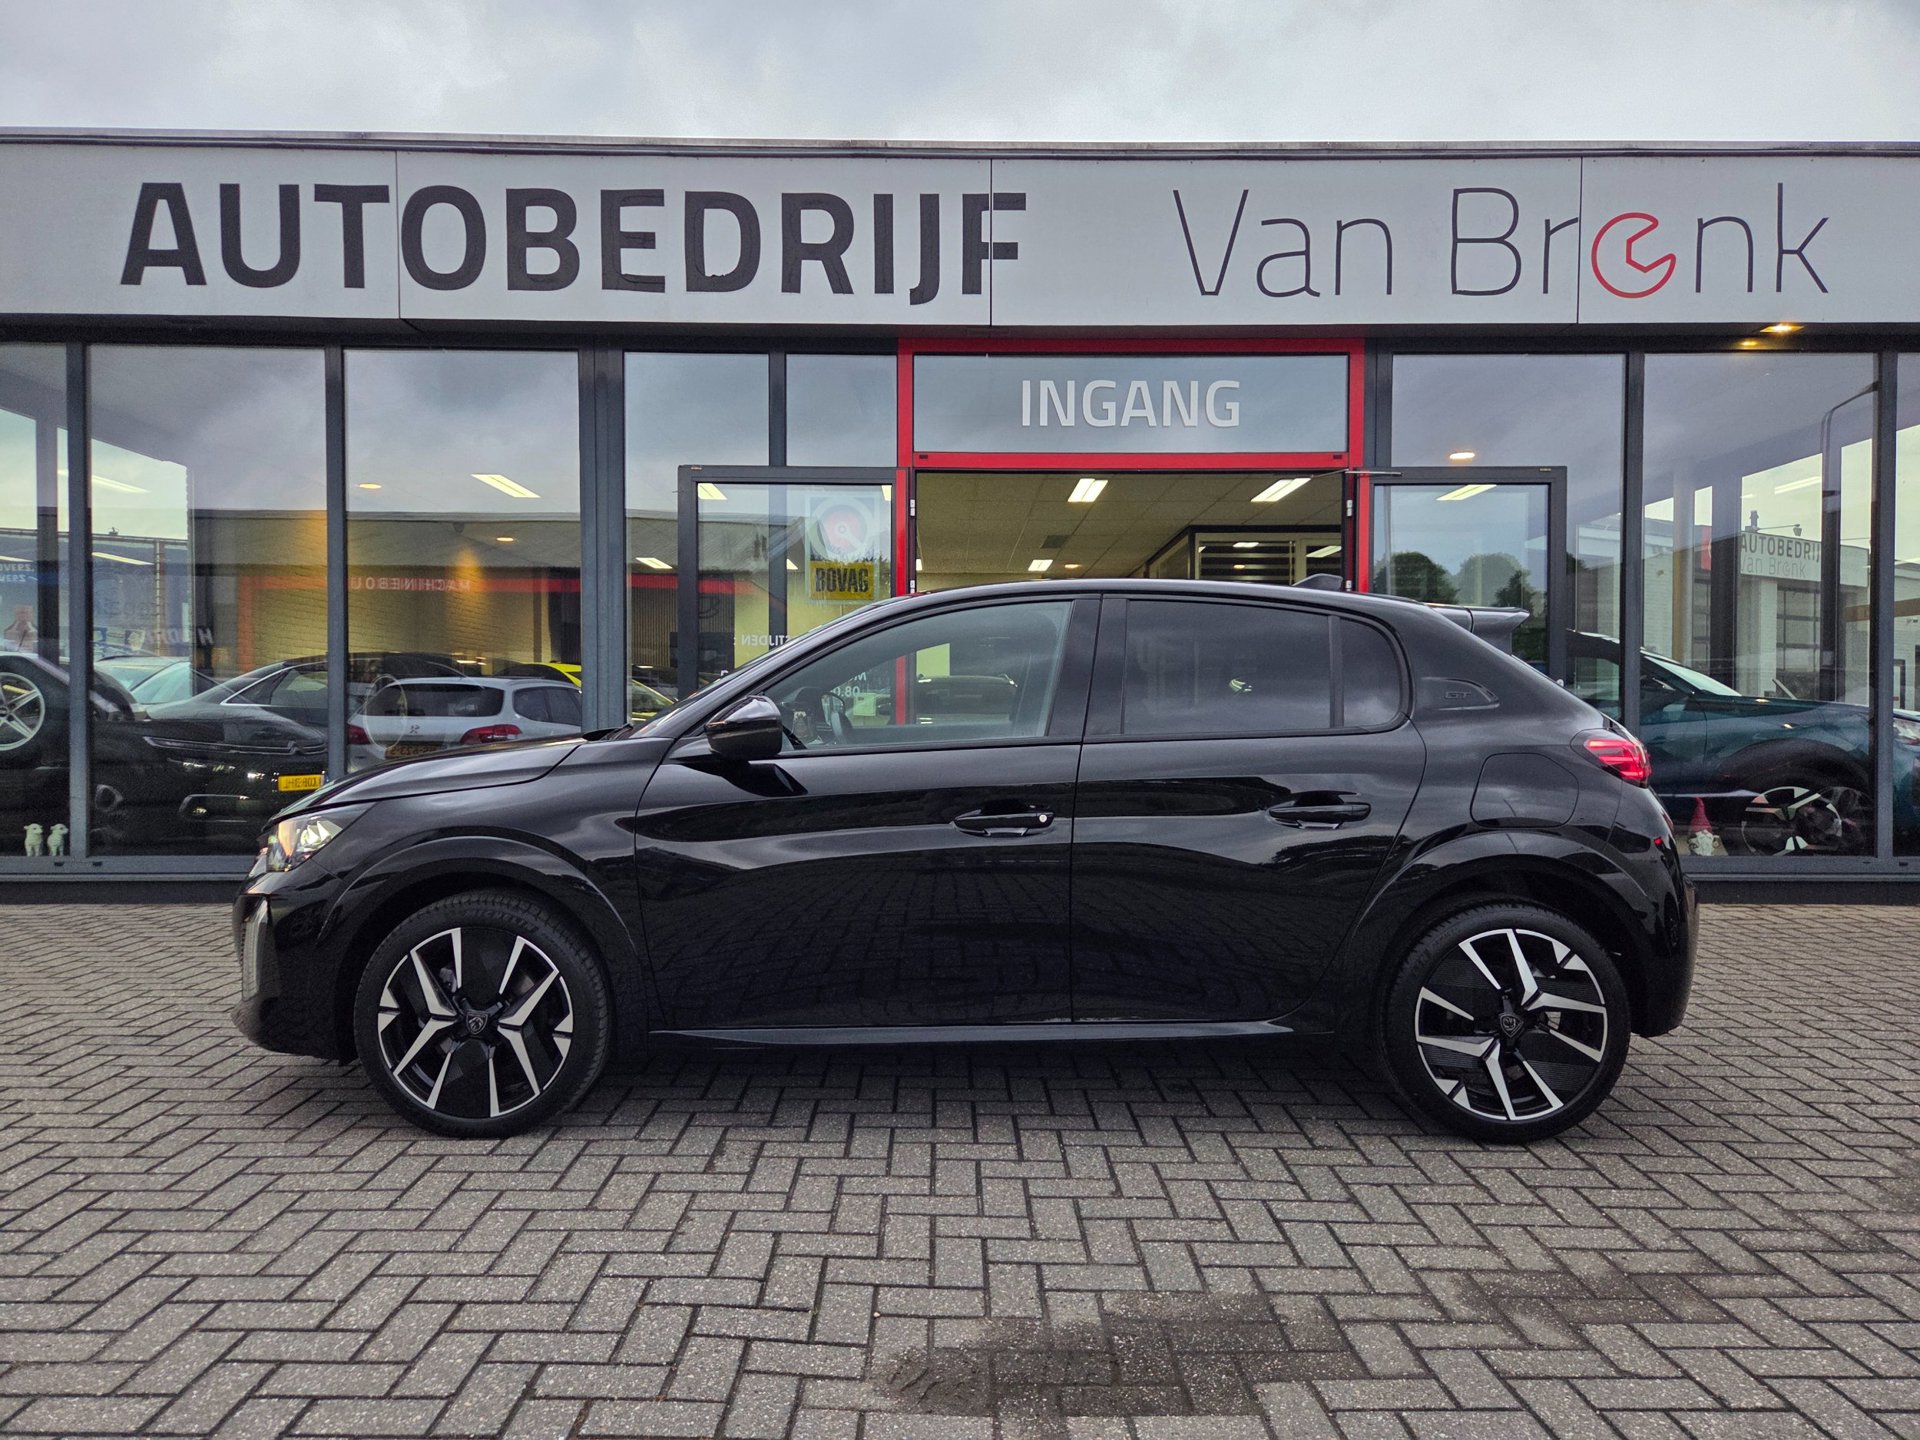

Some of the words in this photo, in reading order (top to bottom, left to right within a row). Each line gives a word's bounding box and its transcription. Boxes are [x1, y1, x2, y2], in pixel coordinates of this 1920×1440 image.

[120, 182, 1027, 305] AUTOBEDRIJF
[1172, 189, 1321, 298] Van
[1021, 379, 1241, 428] INGANG
[1741, 534, 1820, 562] AUTOBEDRIJ
[815, 567, 869, 593] BOVAG
